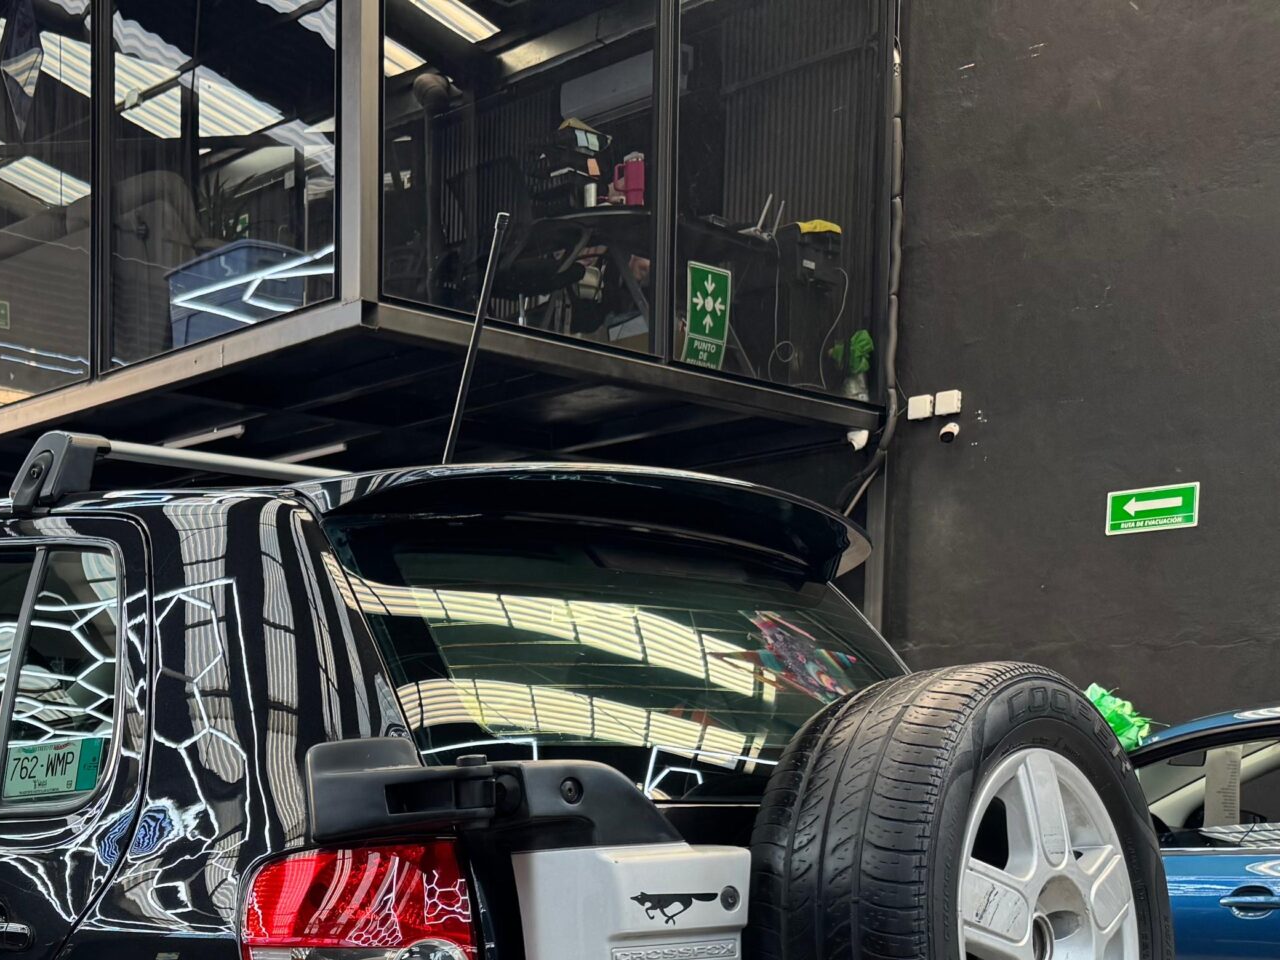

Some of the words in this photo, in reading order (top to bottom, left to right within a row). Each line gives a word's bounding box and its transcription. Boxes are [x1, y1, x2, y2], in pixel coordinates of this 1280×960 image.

[693, 340, 716, 353] PUNTO
[698, 351, 708, 361] DE
[1120, 521, 1136, 529] RUTA
